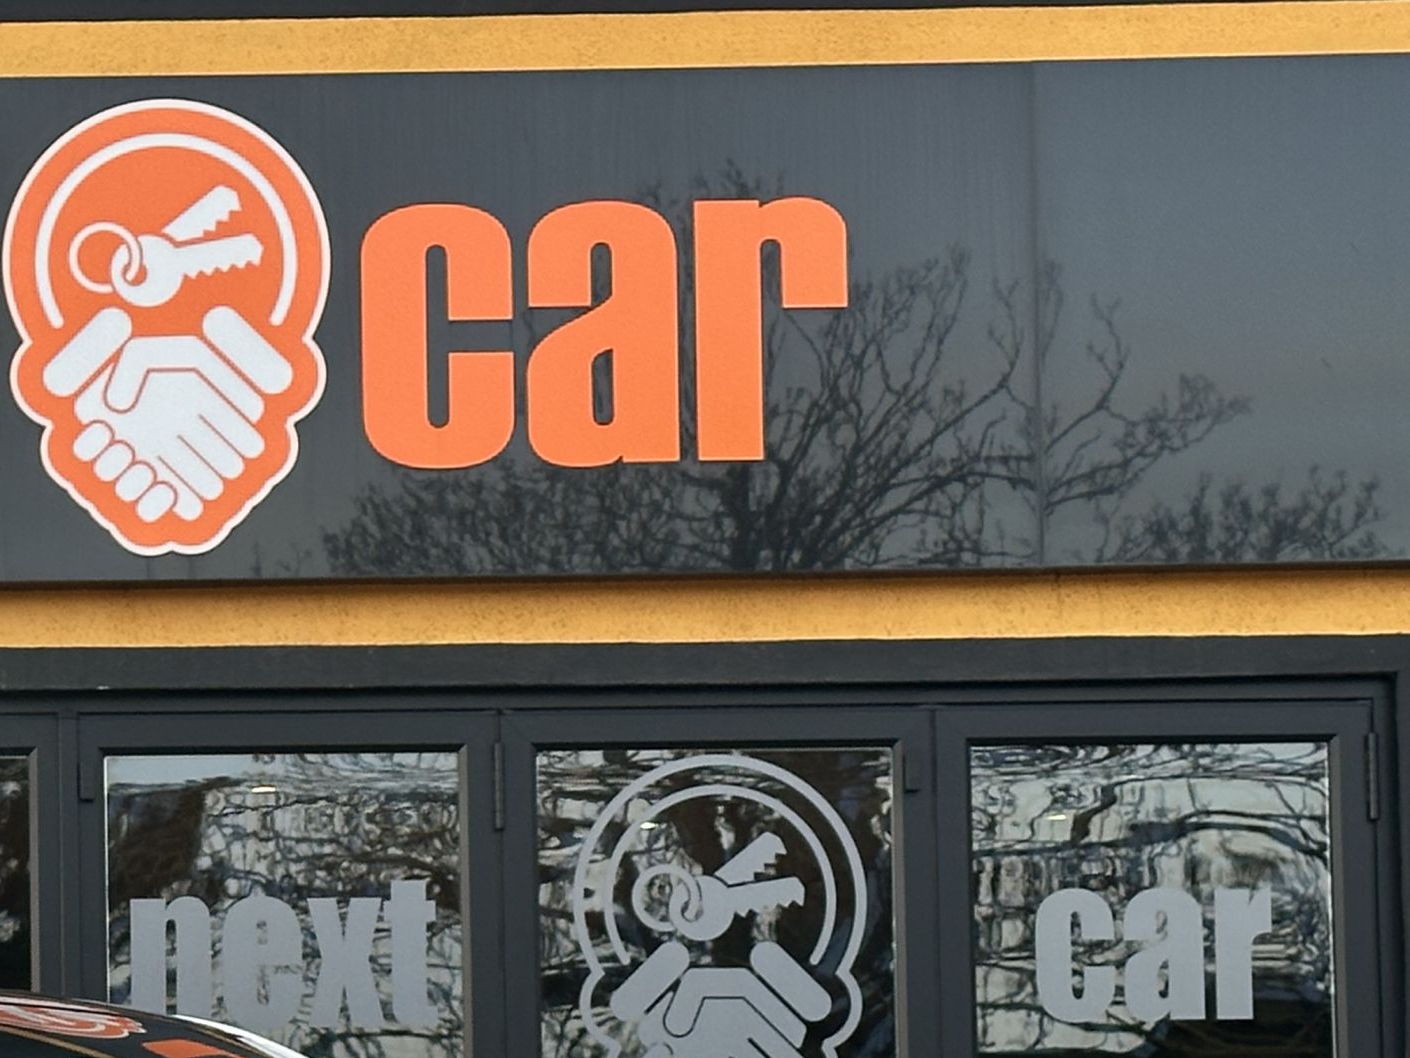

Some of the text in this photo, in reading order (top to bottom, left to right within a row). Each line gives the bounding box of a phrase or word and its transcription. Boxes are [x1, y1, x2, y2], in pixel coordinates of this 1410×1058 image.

[360, 196, 849, 470] car
[129, 879, 438, 1029] next
[1035, 887, 1273, 1021] car
